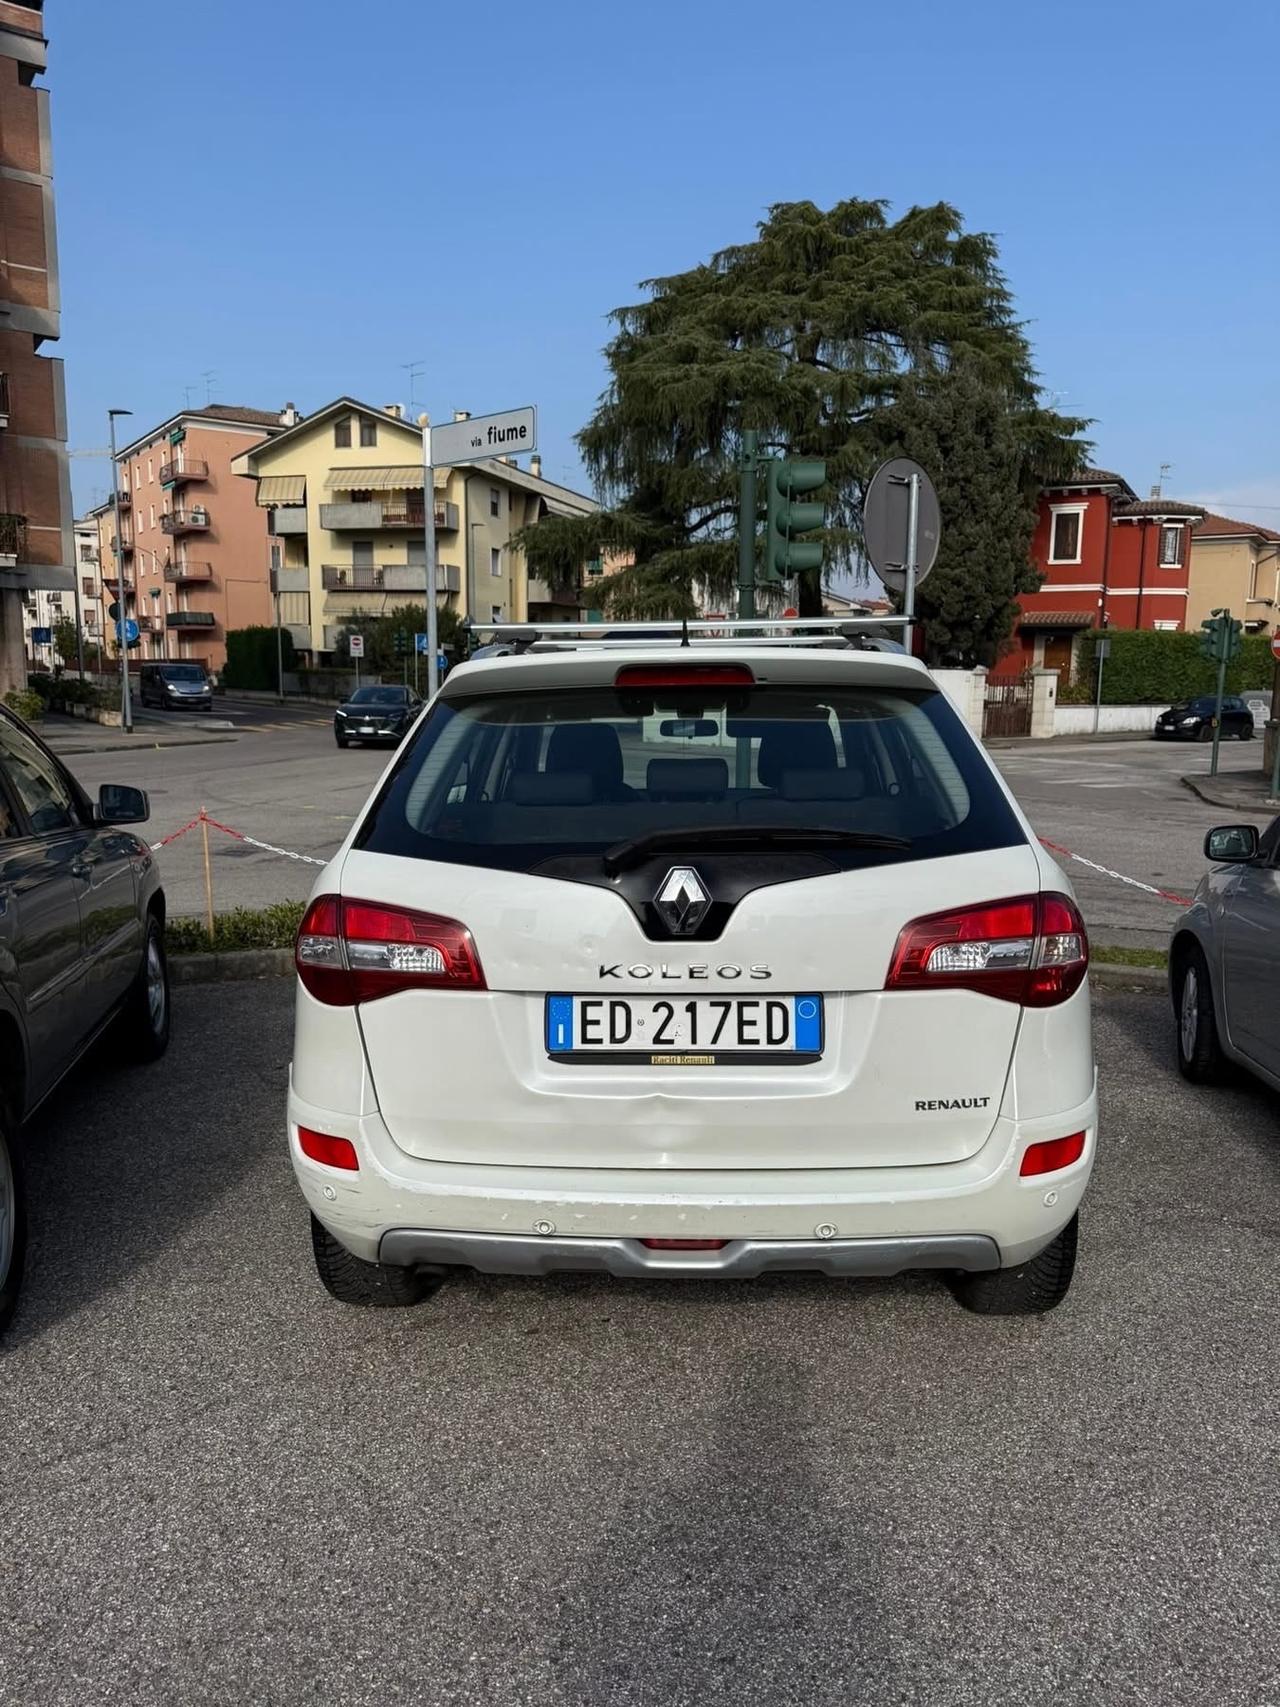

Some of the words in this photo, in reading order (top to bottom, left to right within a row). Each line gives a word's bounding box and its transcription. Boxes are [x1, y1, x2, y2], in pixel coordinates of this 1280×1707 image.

[471, 436, 482, 447] via
[487, 425, 527, 444] fiume
[599, 964, 772, 979] KOLEOS
[580, 1001, 632, 1045] ED
[652, 1001, 790, 1045] 217ED
[915, 1097, 990, 1111] RENAULT
